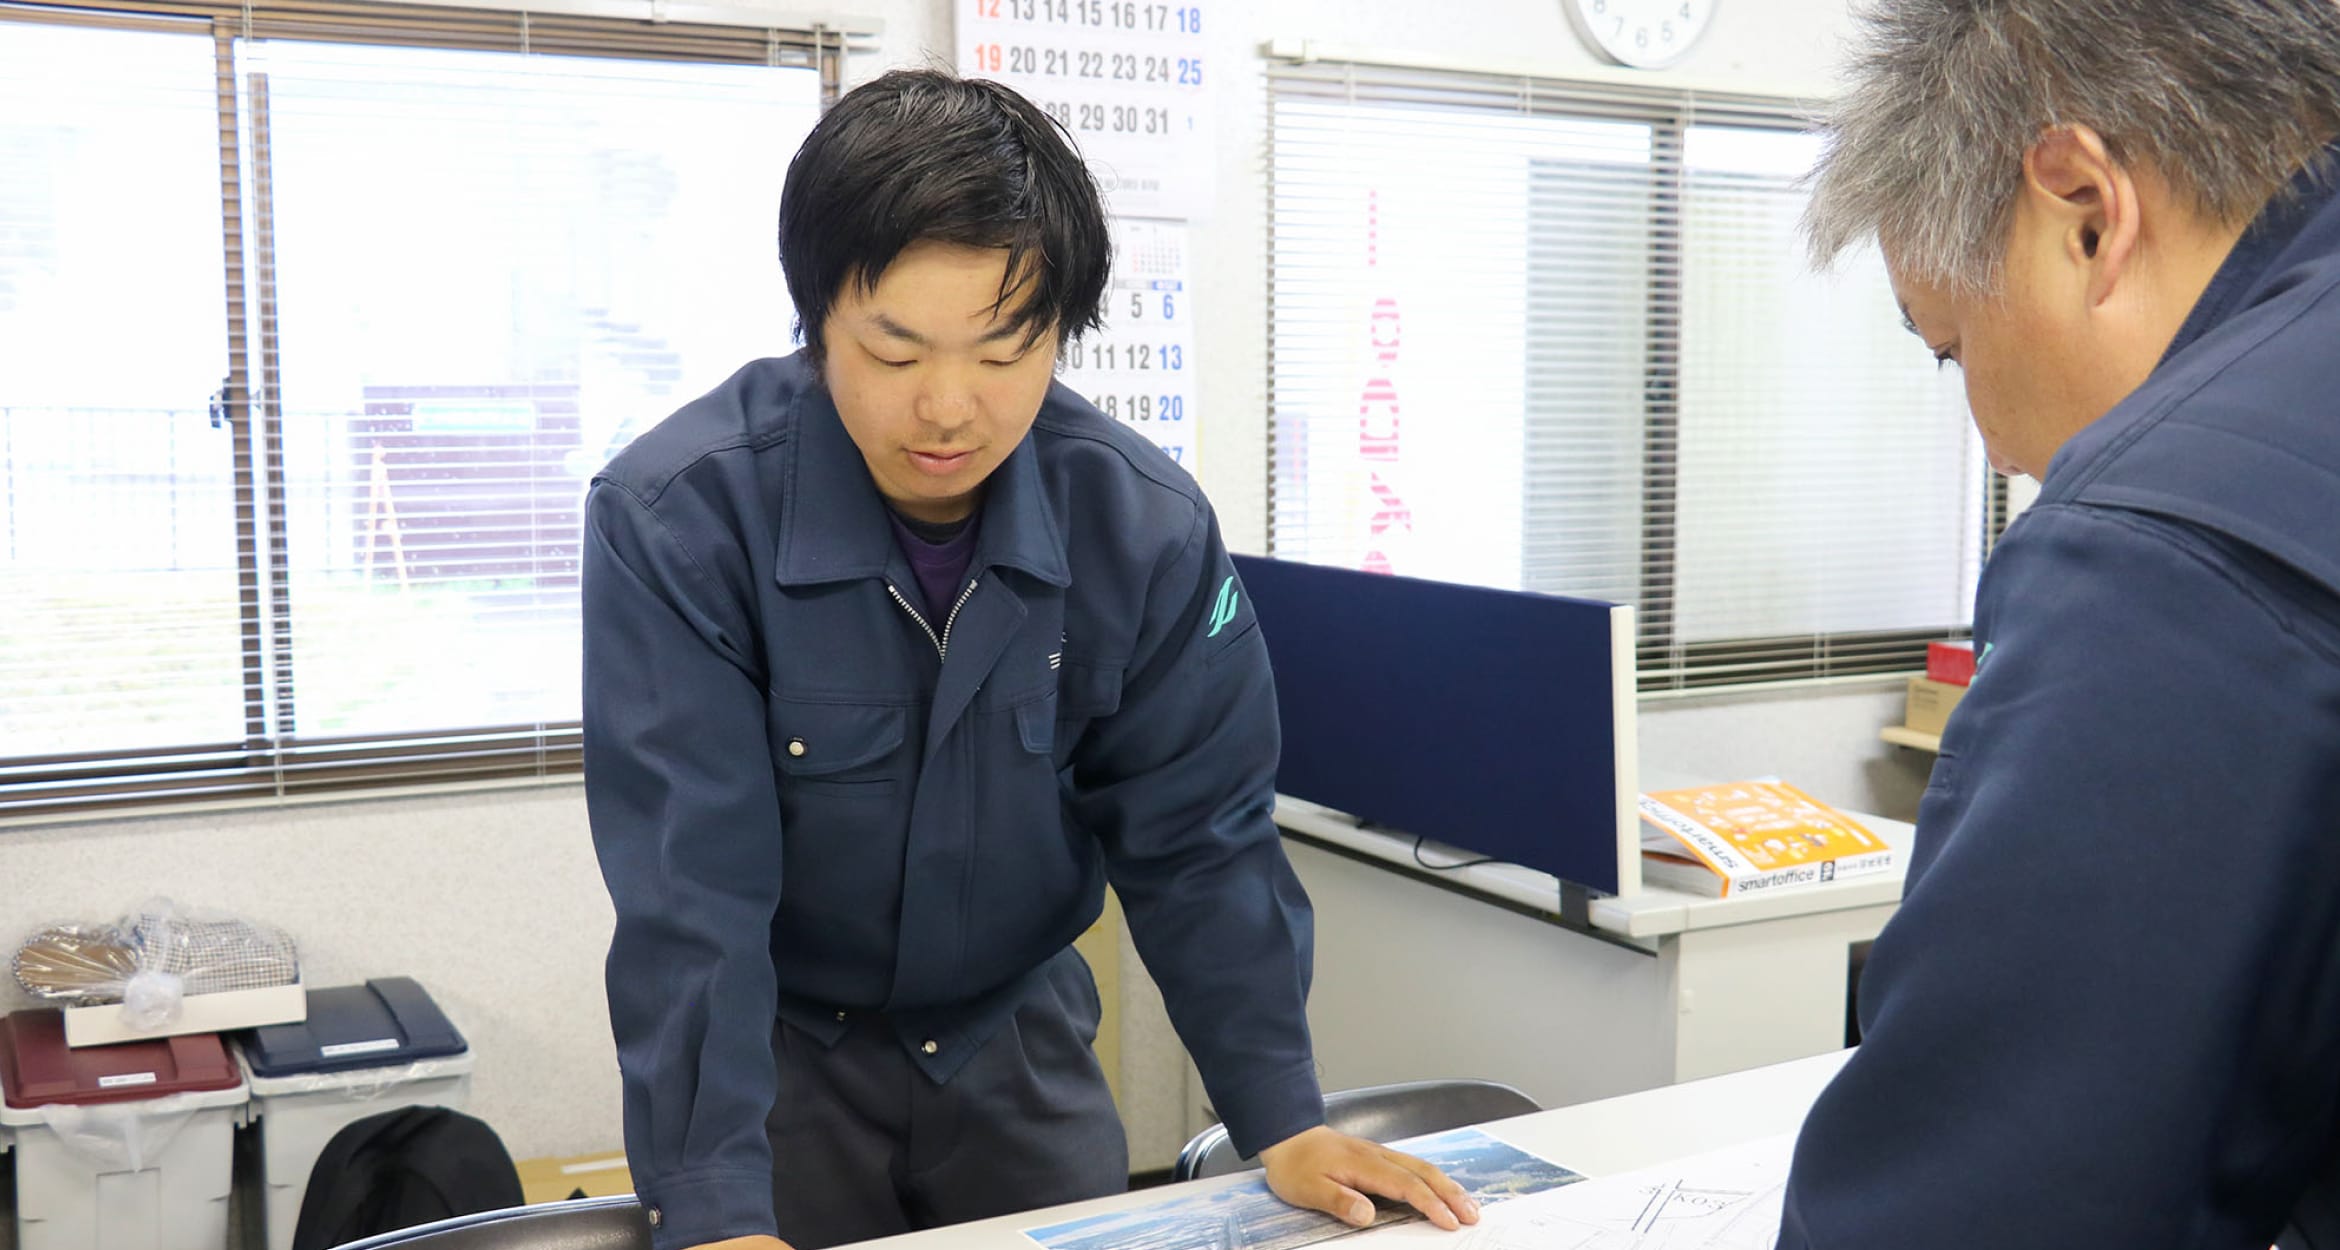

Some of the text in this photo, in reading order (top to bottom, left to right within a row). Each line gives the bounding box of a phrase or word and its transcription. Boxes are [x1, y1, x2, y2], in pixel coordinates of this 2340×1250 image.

[977, 0, 1201, 33] 12 13 14 15 16 17 18
[1616, 16, 1624, 36] 7
[1636, 27, 1648, 48] 6
[975, 44, 1201, 85] 19 20 21 22 23 24 25
[1080, 104, 1104, 131] 29
[1113, 106, 1137, 132] 30
[1145, 108, 1168, 134] 31
[1131, 293, 1142, 318] 5
[1163, 294, 1174, 320] 6
[1092, 344, 1115, 370] 11
[1126, 344, 1149, 370] 12
[1159, 344, 1183, 370] 13
[1126, 396, 1149, 421] 19
[1159, 396, 1183, 421] 20
[1738, 868, 1815, 892] smartoffice
